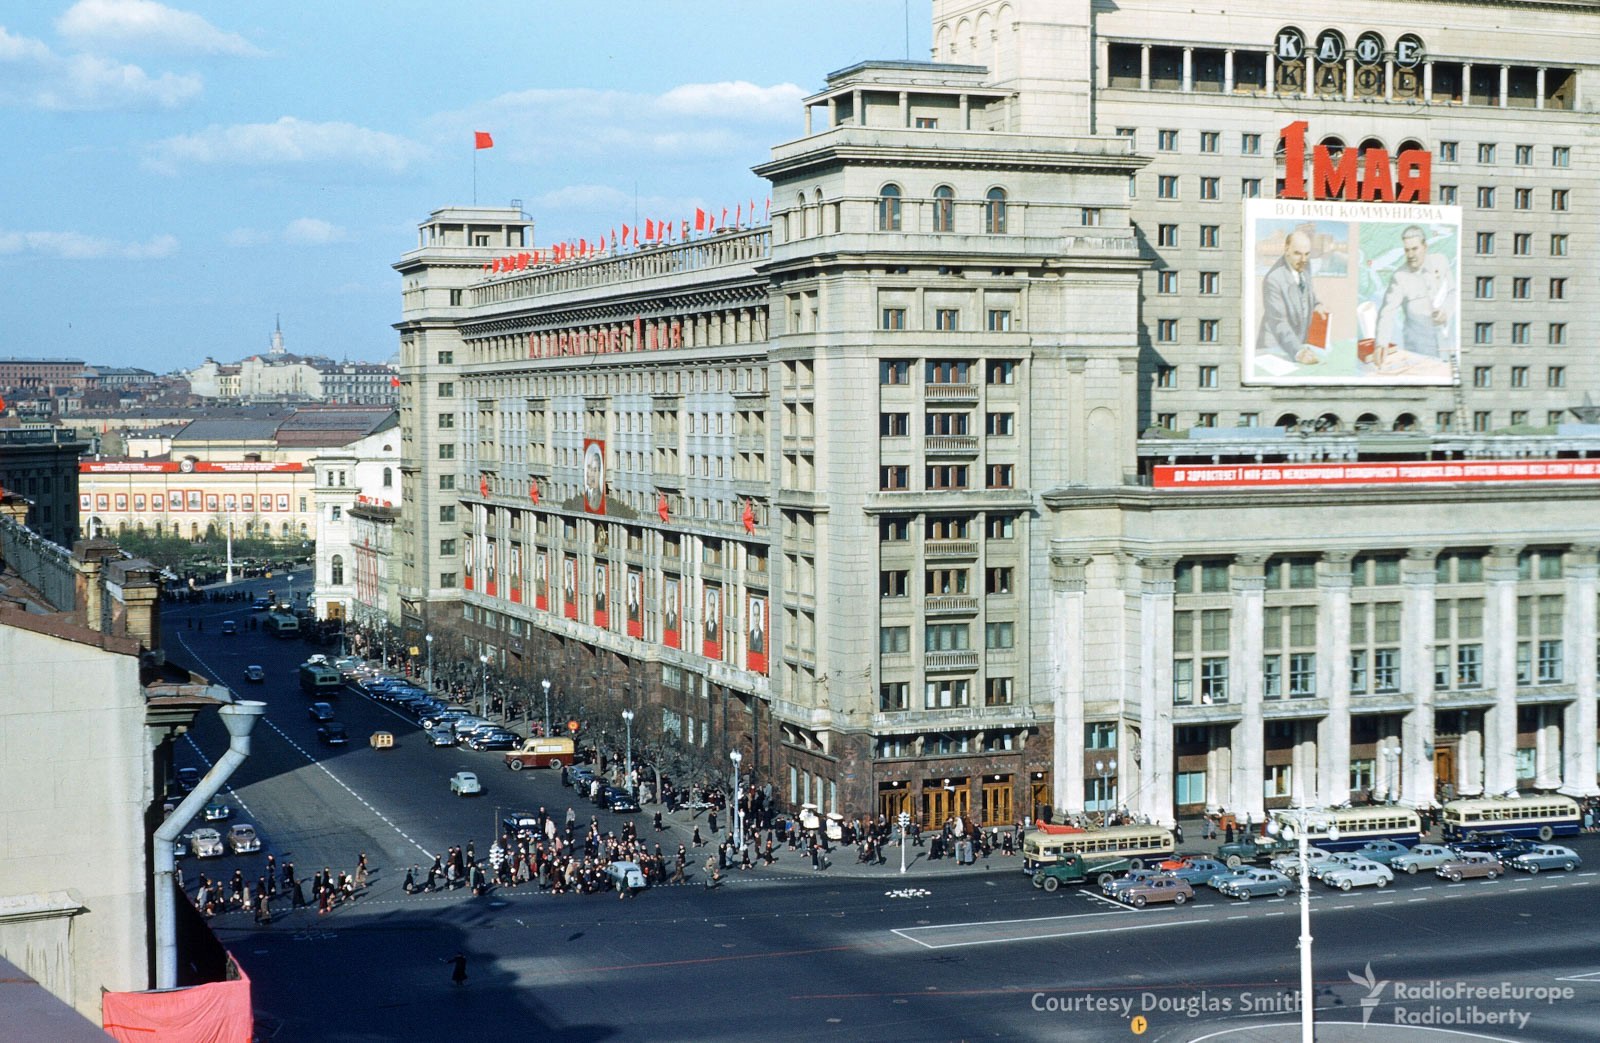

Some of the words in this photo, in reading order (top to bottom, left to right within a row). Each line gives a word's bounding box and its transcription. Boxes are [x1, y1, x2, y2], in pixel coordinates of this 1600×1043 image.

[1279, 34, 1420, 63] КАФЕ
[1280, 120, 1309, 199] 1
[1313, 145, 1432, 203] МАЯ
[1275, 203, 1296, 216] ВО
[1302, 204, 1334, 217] ИМЯ
[1340, 205, 1444, 220] КОММУНИЗМА
